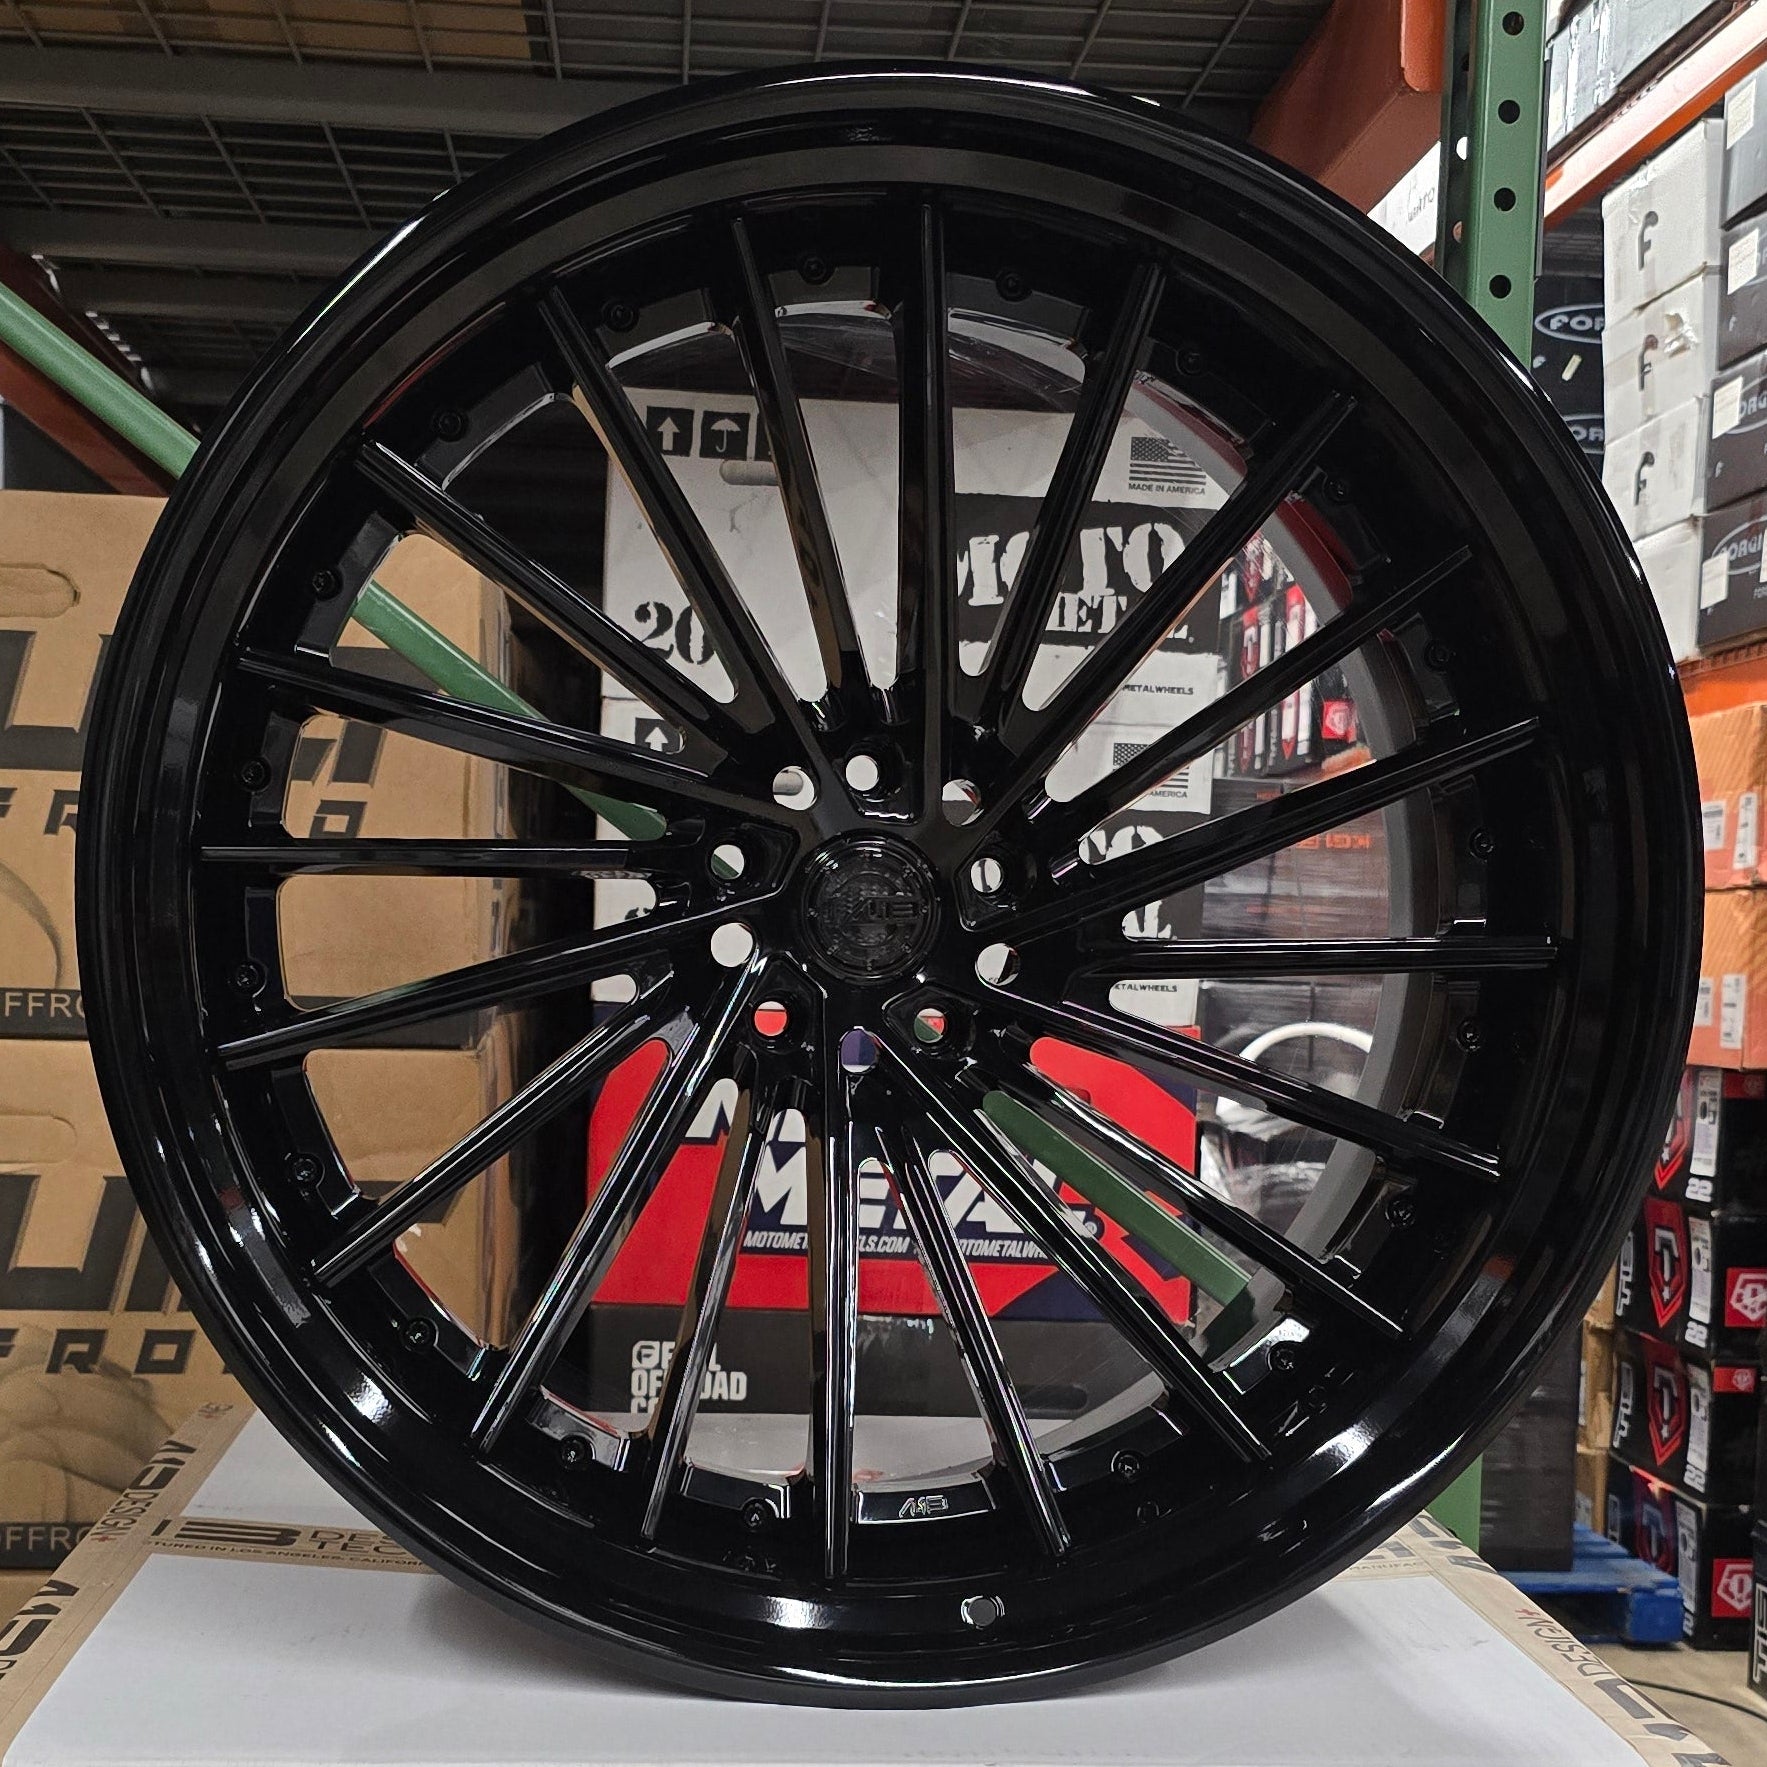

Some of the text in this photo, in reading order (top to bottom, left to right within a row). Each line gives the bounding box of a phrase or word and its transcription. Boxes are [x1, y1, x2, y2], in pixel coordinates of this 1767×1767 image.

[1128, 482, 1206, 496] MADE IN AMERICA
[634, 601, 717, 665] 20
